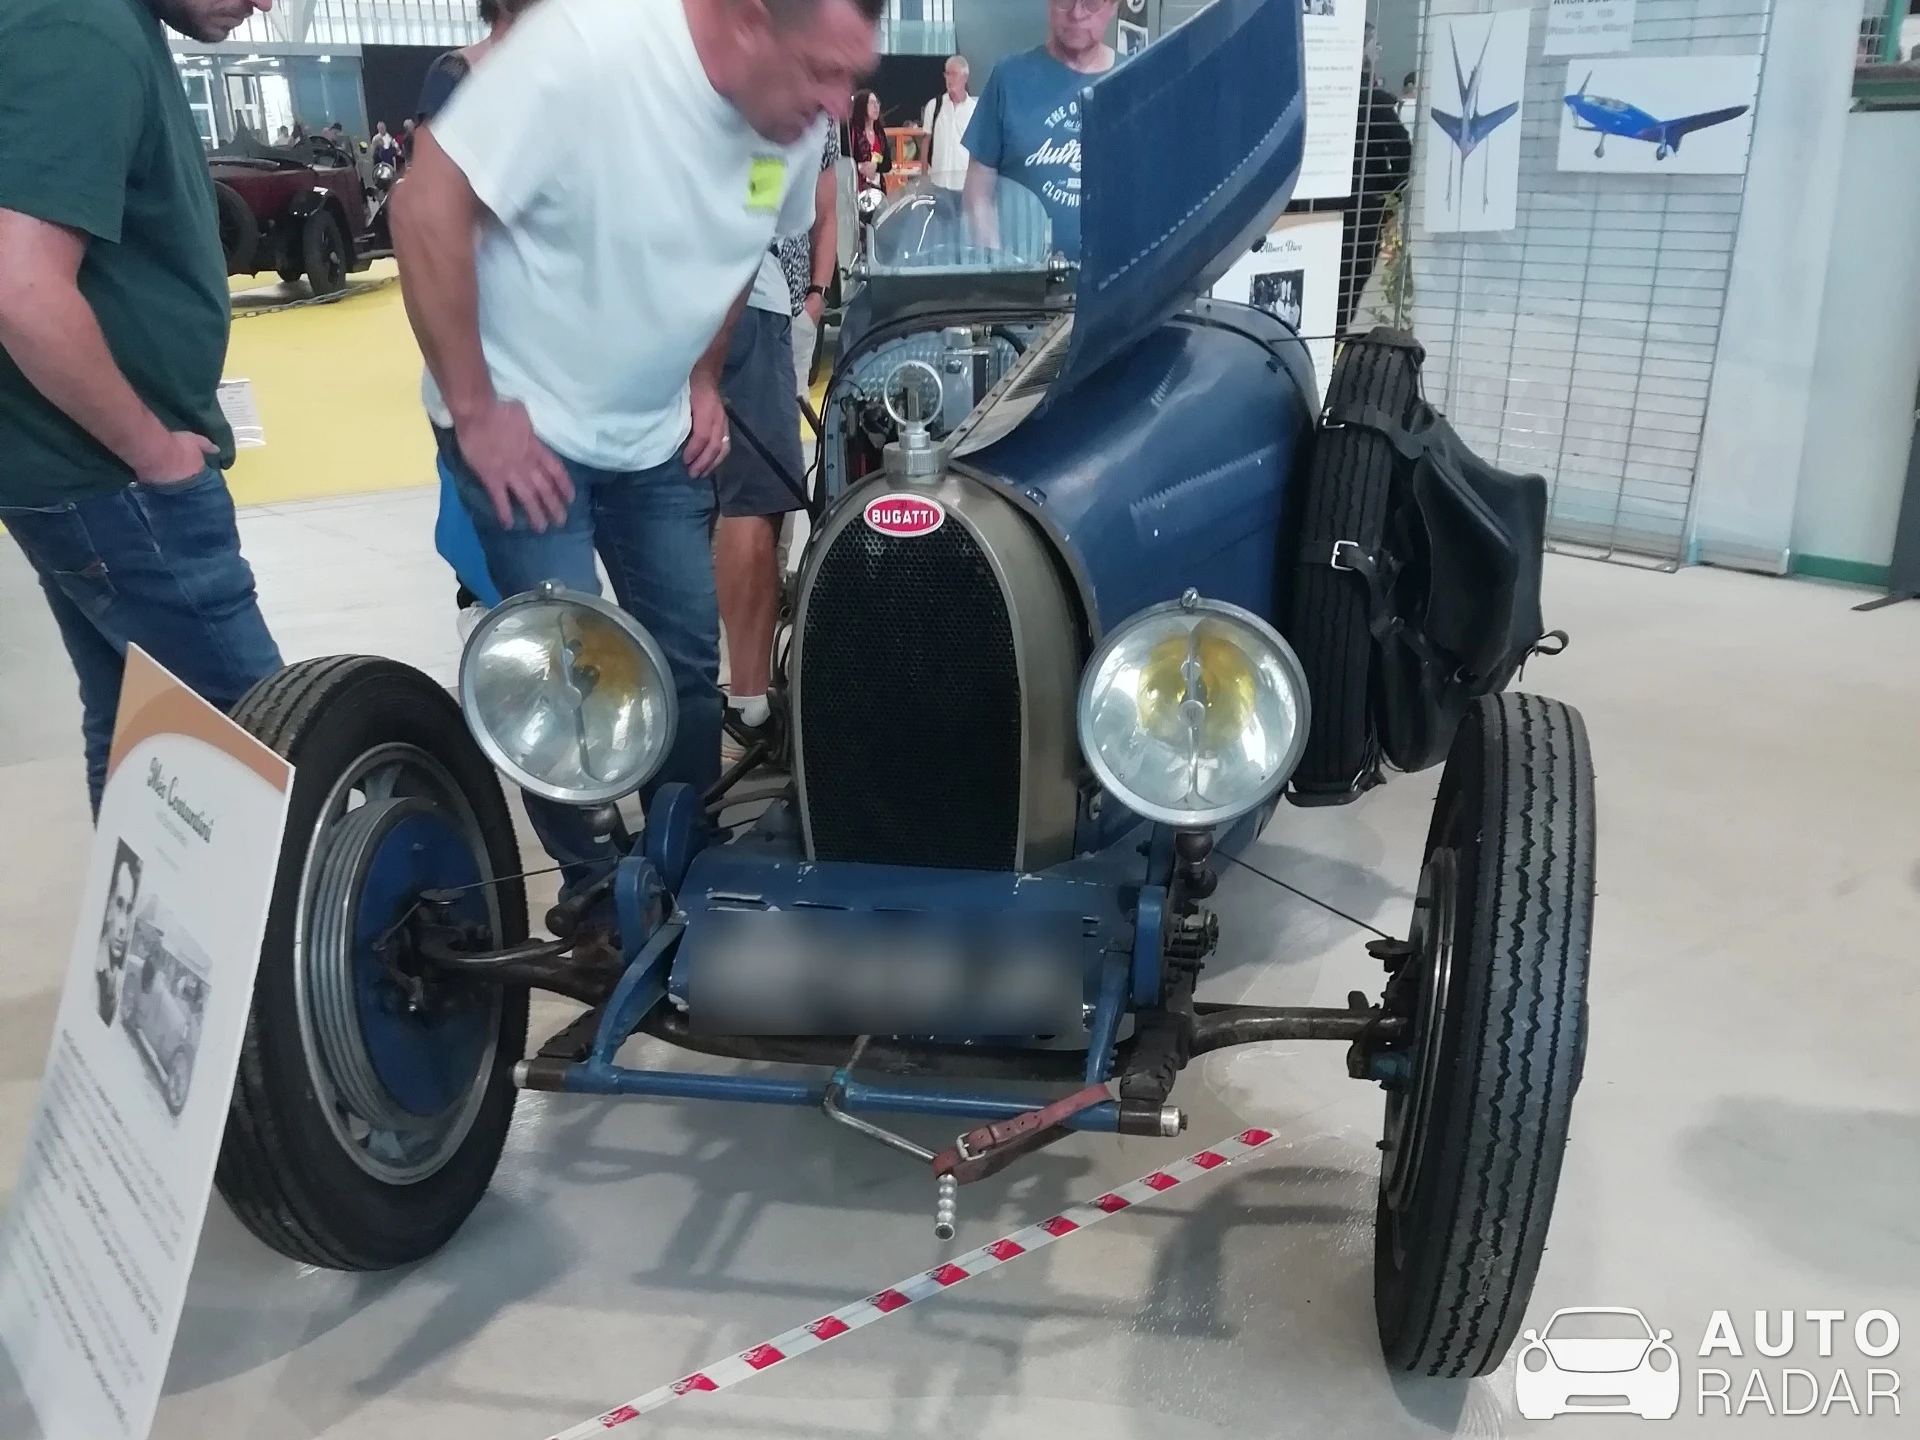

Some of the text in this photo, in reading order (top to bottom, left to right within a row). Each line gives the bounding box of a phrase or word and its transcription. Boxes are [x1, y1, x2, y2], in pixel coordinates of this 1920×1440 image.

[1044, 105, 1067, 129] THE
[1069, 101, 1078, 116] O
[1025, 138, 1081, 167] Auth
[1042, 180, 1080, 208] CLOTHI
[872, 509, 934, 525] BUGATTI
